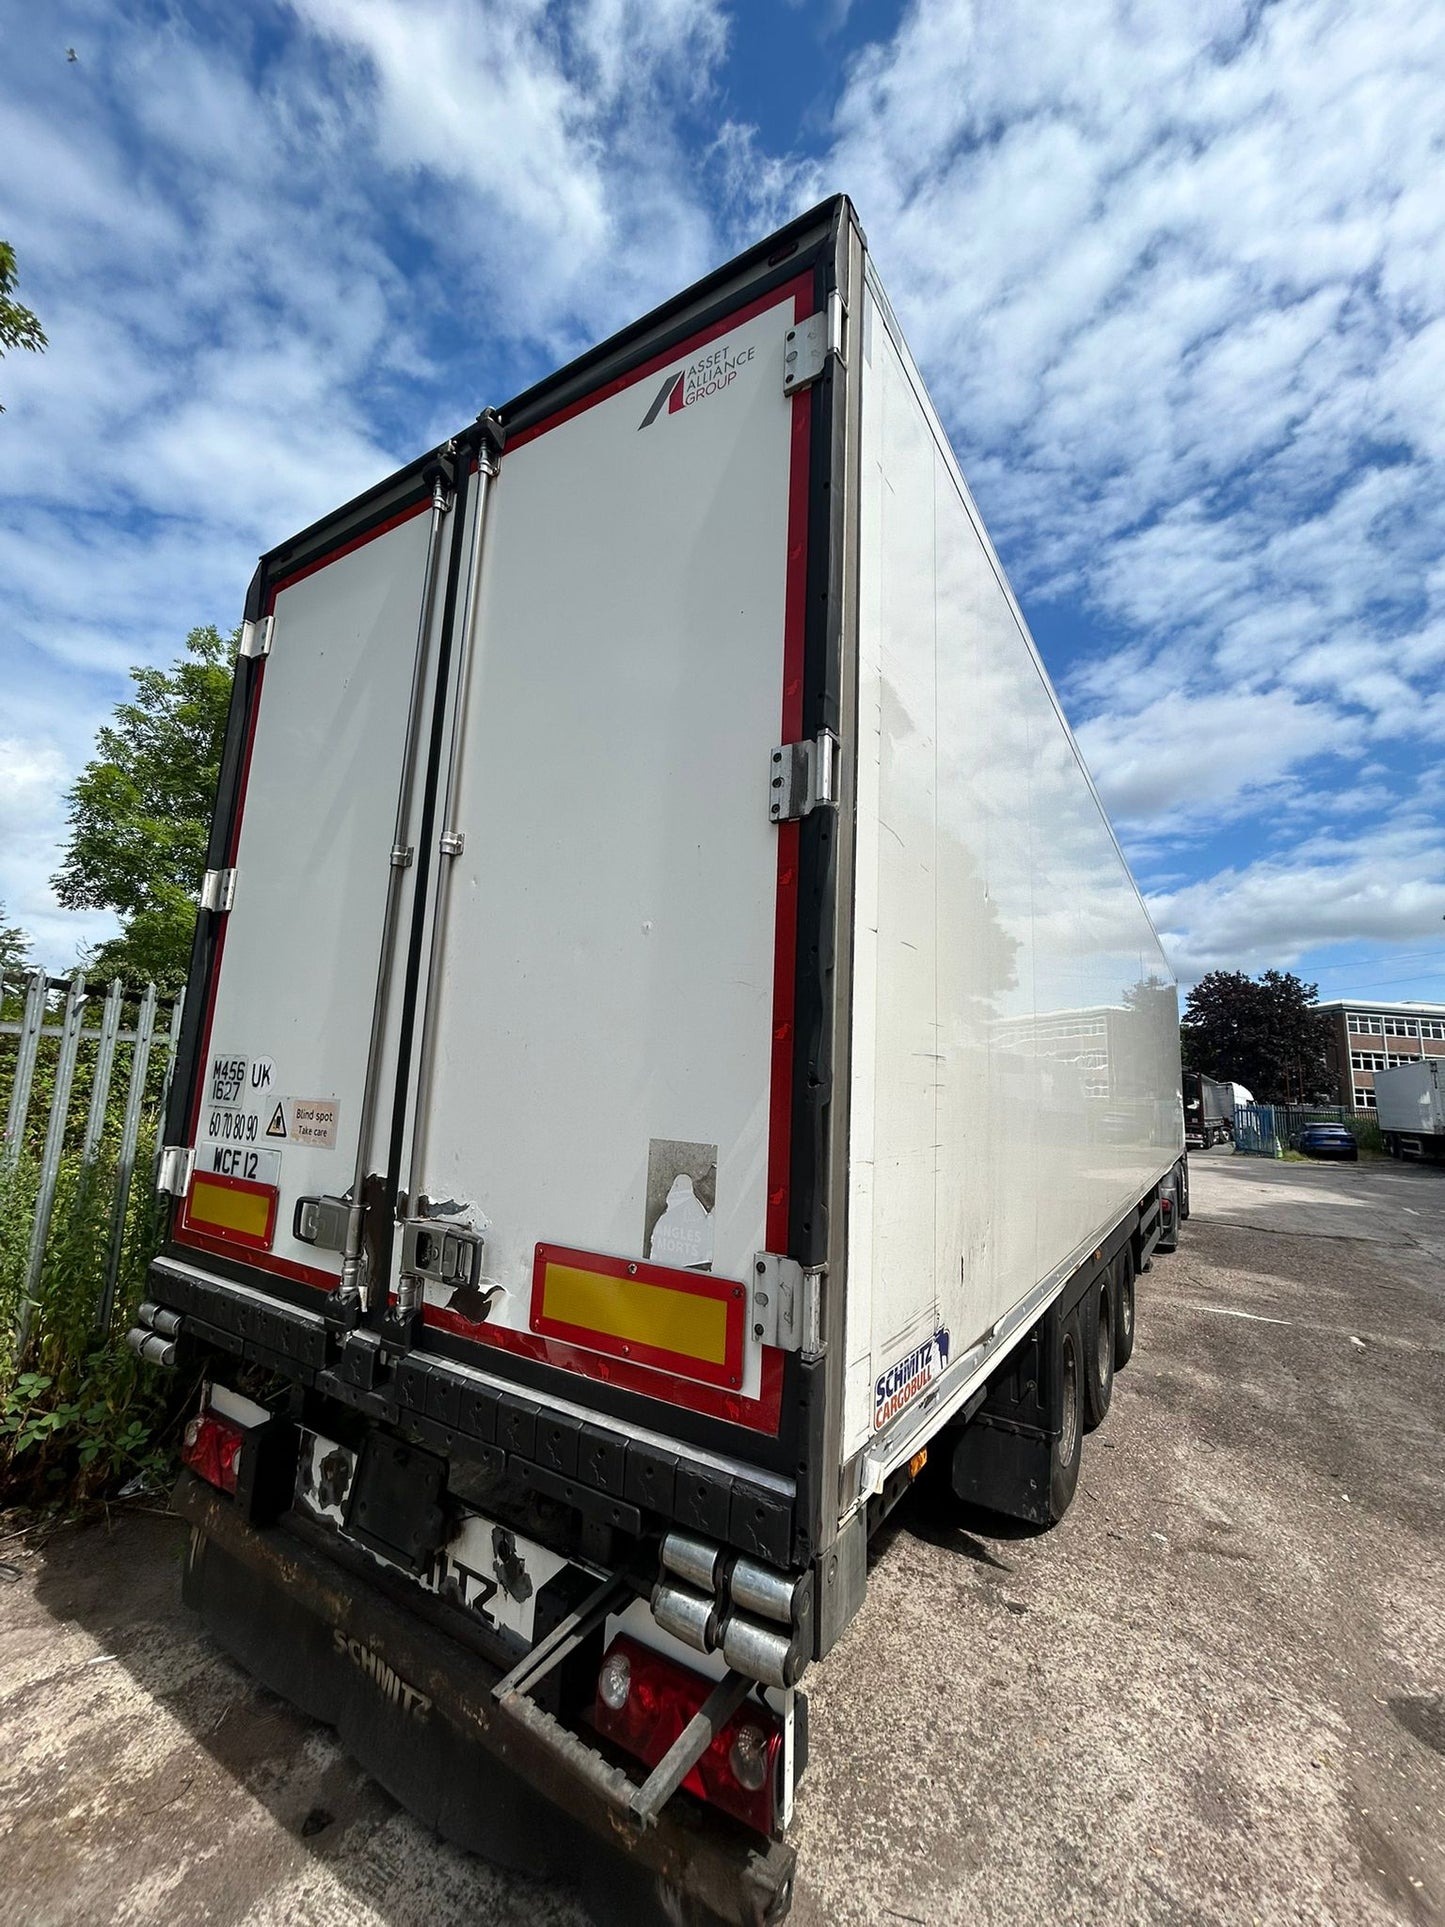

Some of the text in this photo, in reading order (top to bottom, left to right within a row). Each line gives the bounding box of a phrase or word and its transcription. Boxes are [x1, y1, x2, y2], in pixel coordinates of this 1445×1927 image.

[686, 347, 755, 392] ALLIANCE
[687, 346, 730, 379] ASSET
[685, 371, 737, 406] GROUP
[212, 1060, 246, 1082] M456
[251, 1063, 272, 1088] UK
[212, 1081, 241, 1102] 1627
[208, 1112, 259, 1142] 60 70 80 90
[296, 1108, 333, 1126] Blind spot
[298, 1125, 328, 1138] Take care
[212, 1147, 259, 1179] WCF 12
[876, 1338, 934, 1408] SCHMITZ
[875, 1364, 932, 1429] CARGOBULL
[333, 1627, 433, 1724] SCHMITZ
